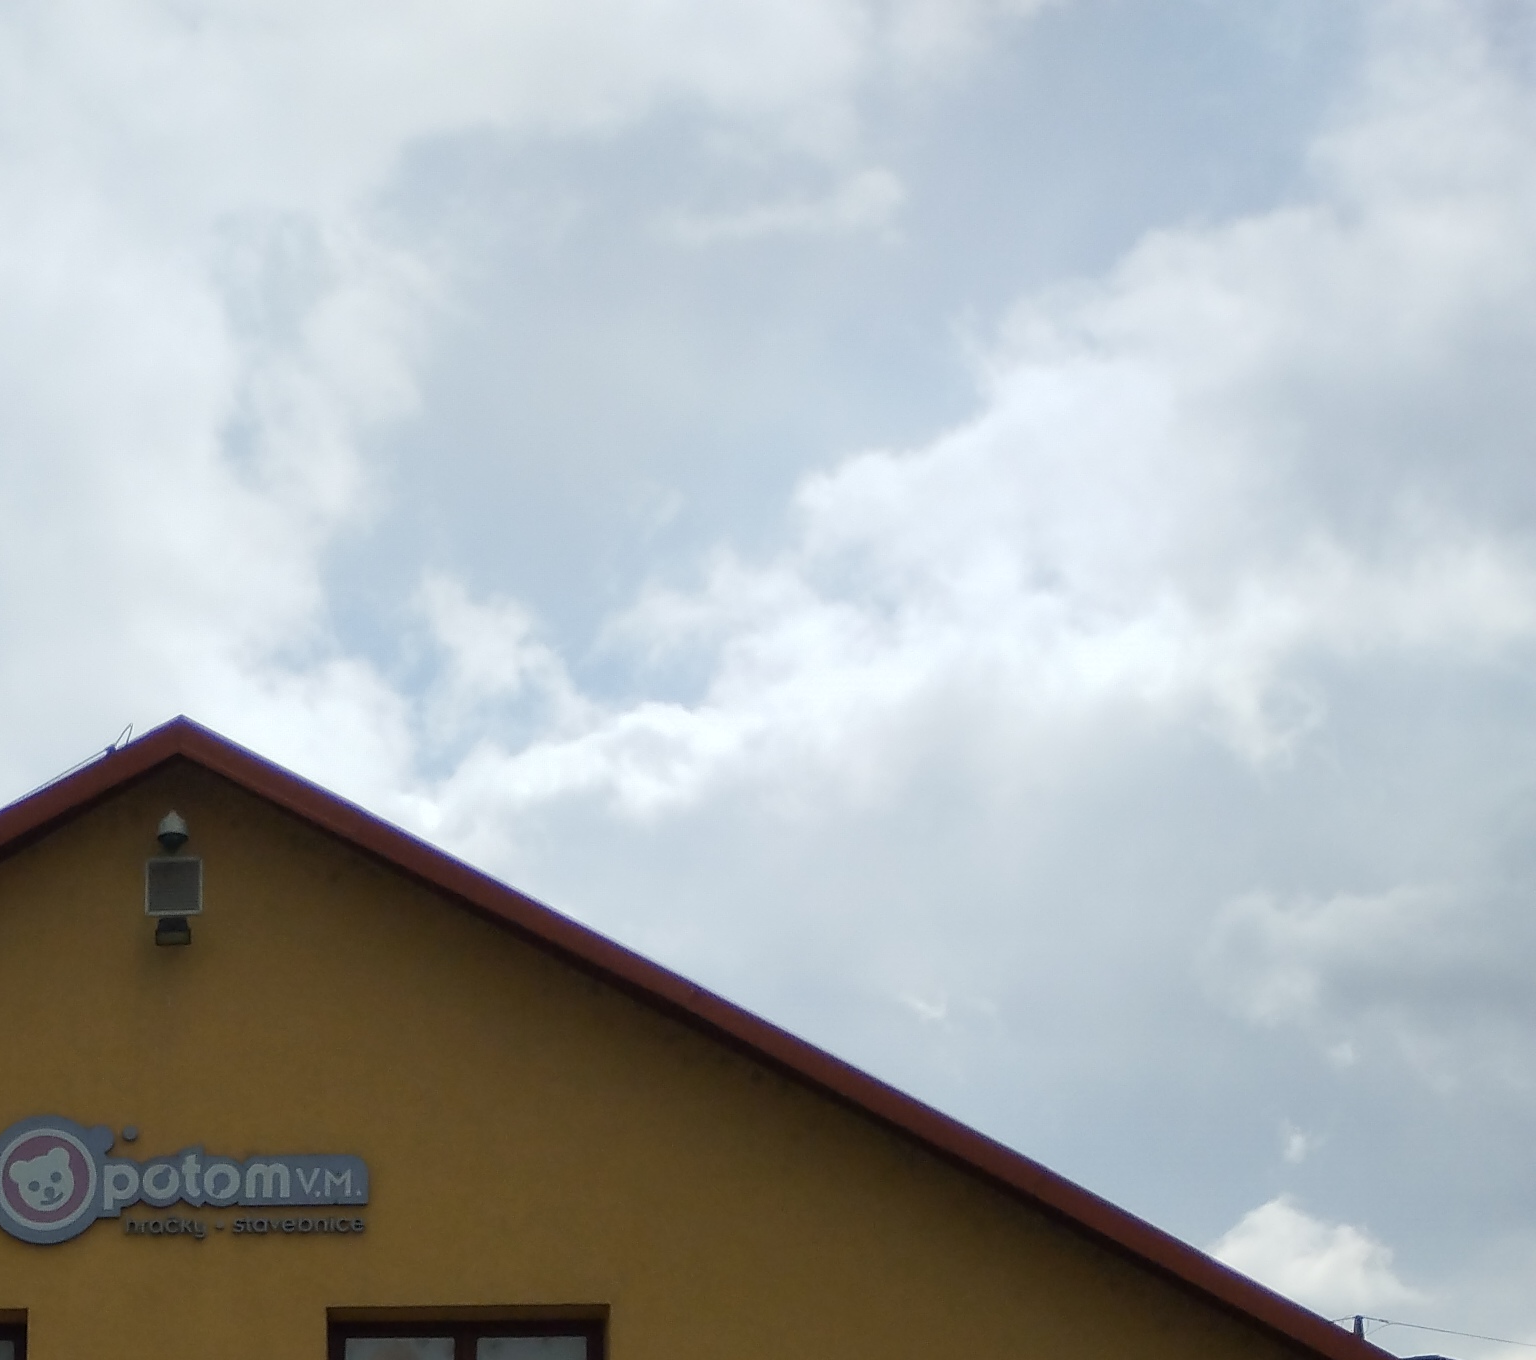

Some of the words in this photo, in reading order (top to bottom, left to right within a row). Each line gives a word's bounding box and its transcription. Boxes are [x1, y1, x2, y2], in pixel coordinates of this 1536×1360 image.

[103, 1153, 290, 1210] potom
[296, 1166, 362, 1197] V.M.
[232, 1216, 366, 1235] stavebnice
